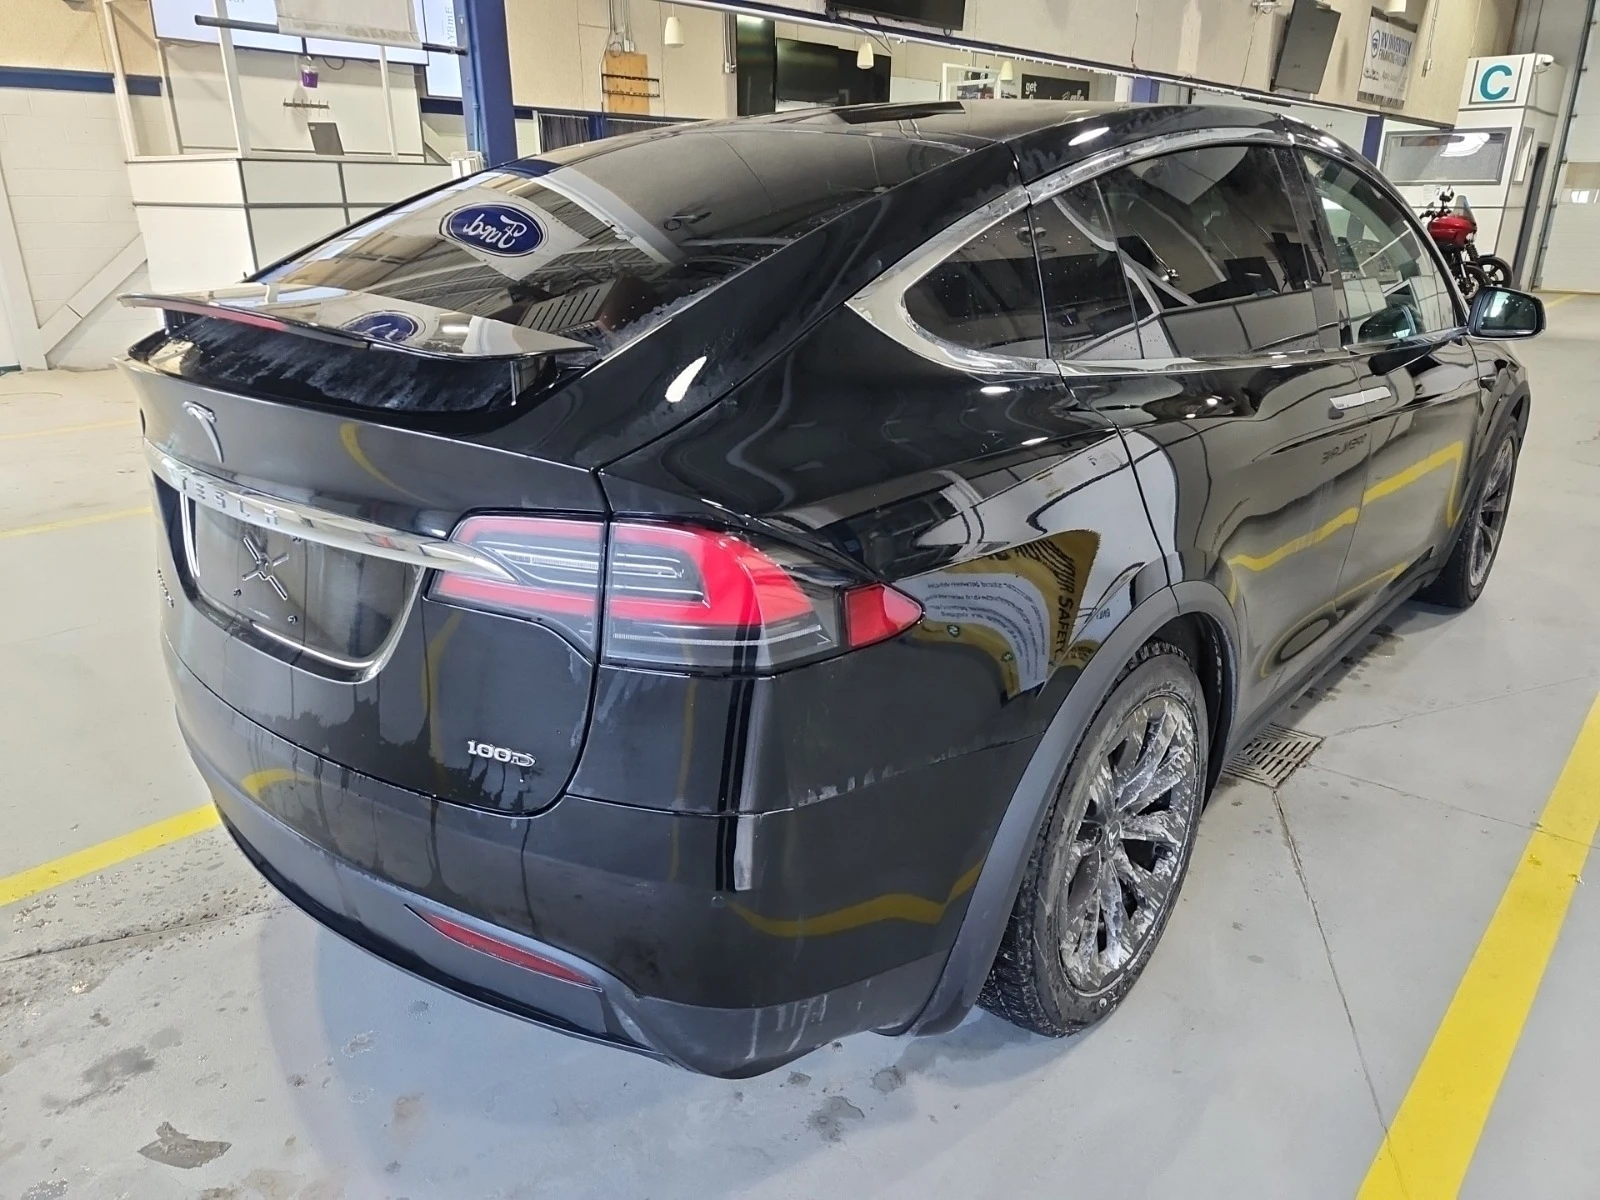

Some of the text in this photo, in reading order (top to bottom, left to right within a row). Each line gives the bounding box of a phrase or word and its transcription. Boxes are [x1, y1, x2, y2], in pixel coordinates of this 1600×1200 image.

[1025, 81, 1038, 95] get
[1480, 64, 1512, 101] C
[178, 474, 278, 526] TESLA
[467, 740, 536, 767] 100D
